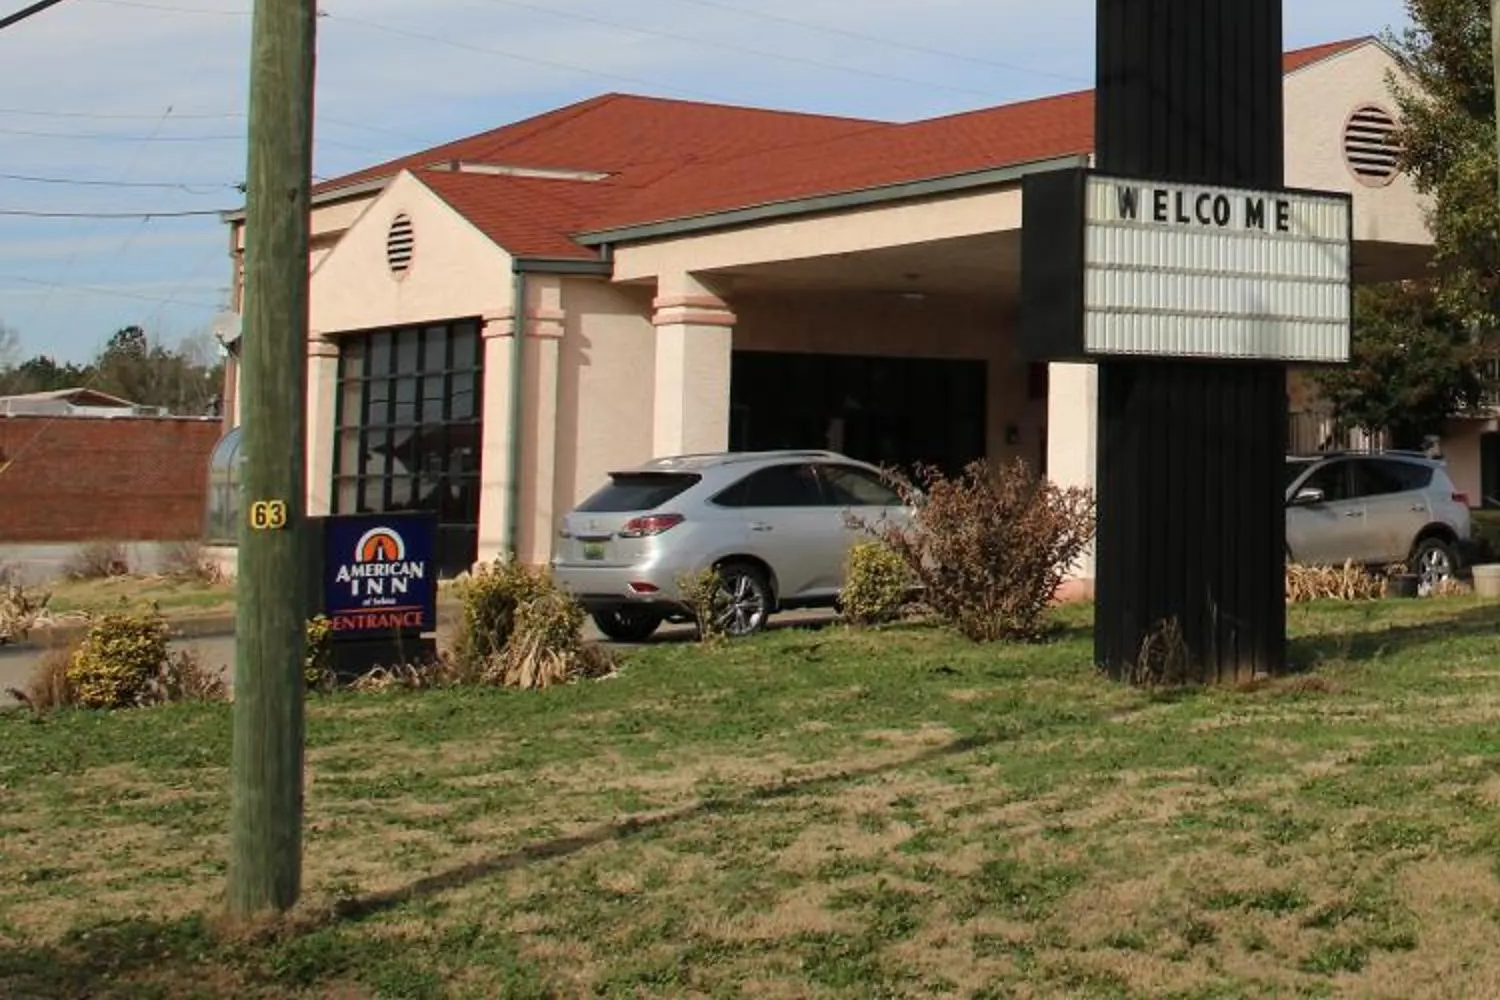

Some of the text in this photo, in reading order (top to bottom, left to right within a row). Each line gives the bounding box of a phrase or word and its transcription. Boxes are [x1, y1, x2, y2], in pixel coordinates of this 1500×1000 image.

[1117, 185, 1289, 232] WELCOME
[254, 502, 283, 527] 63
[336, 561, 423, 583] AMERICAN
[351, 576, 407, 596] INN
[333, 611, 423, 630] ENTRANCE
